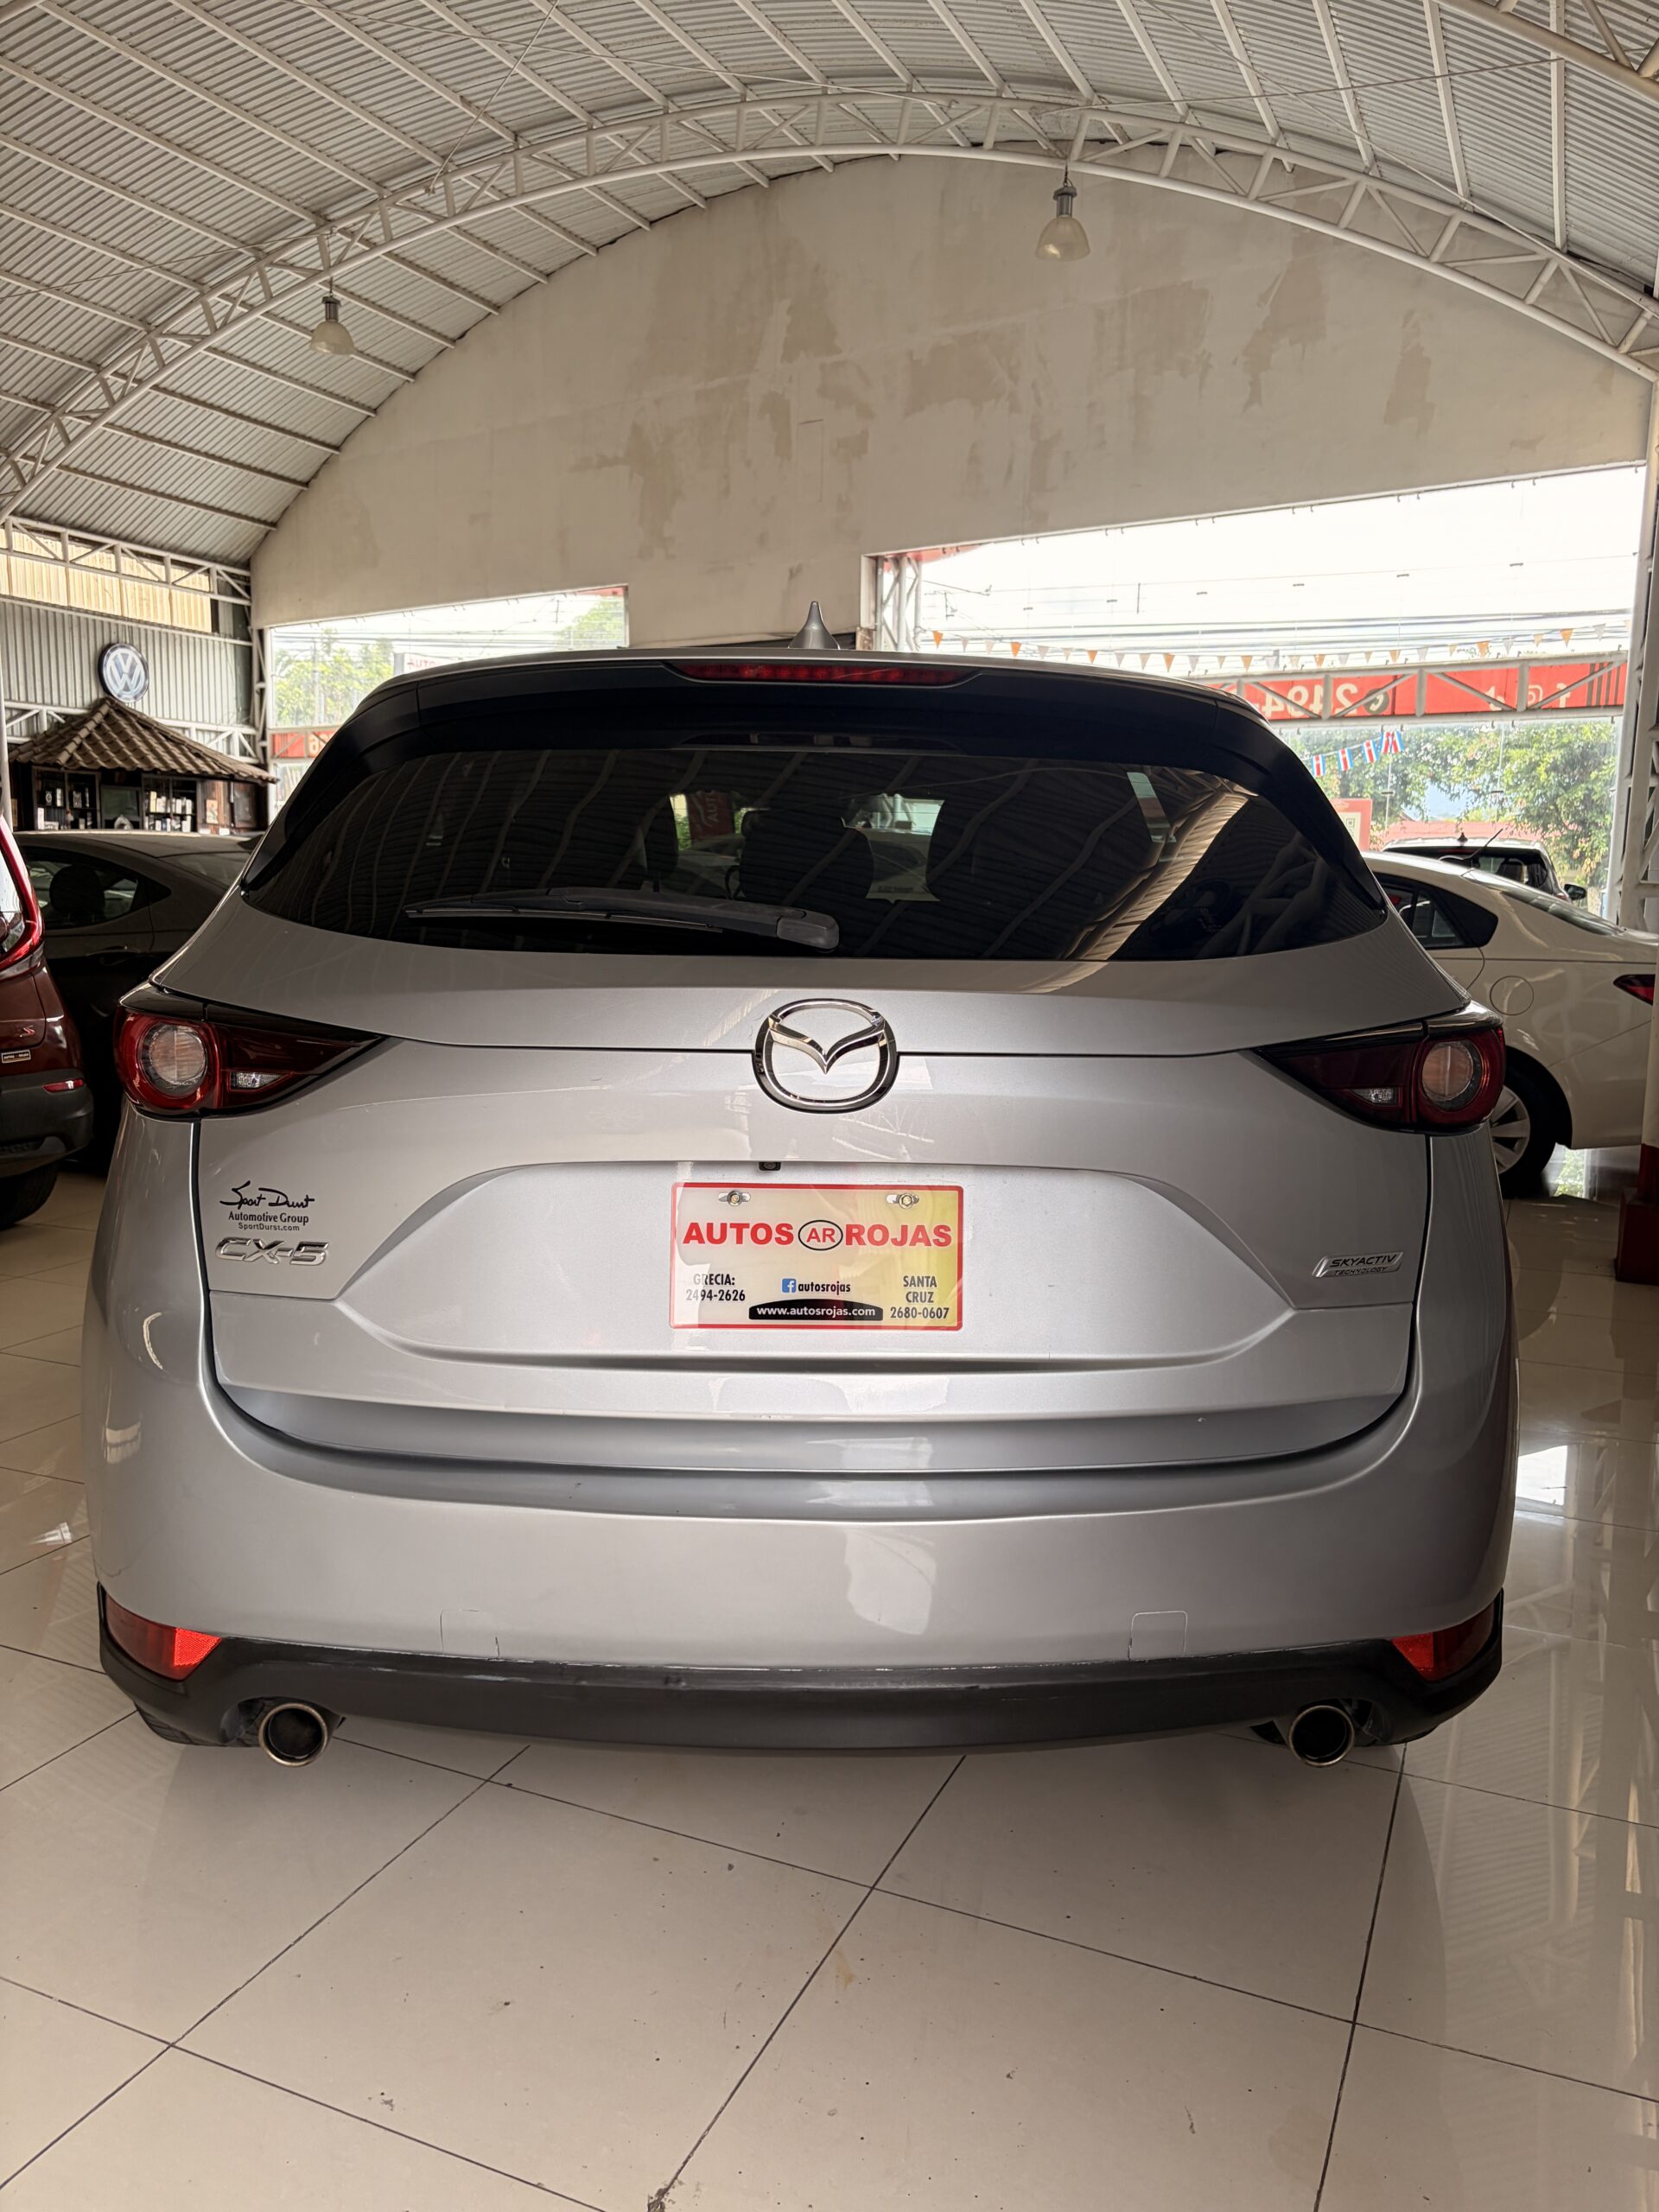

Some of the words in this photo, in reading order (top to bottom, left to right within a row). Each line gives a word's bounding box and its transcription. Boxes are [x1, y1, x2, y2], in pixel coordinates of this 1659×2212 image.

[219, 1180, 266, 1210] Sport
[228, 1211, 278, 1223] Automotive
[279, 1212, 309, 1226] Group
[238, 1222, 301, 1231] SportDurst.com
[683, 1222, 794, 1245] AUTOS
[806, 1228, 836, 1243] AR
[845, 1224, 951, 1247] ROJAS
[215, 1236, 330, 1266] CX-5
[1330, 1254, 1397, 1268] SKYACTIV
[1334, 1267, 1389, 1276] TECHNOLOGY
[693, 1274, 735, 1286] GRECIA:
[903, 1275, 938, 1287] SANTA
[798, 1281, 851, 1295] autosrojas
[686, 1289, 746, 1301] 2494-2626
[906, 1291, 934, 1304] CRUZ
[757, 1306, 876, 1318] www.autosrojas.com
[890, 1306, 950, 1319] 2680-0607
